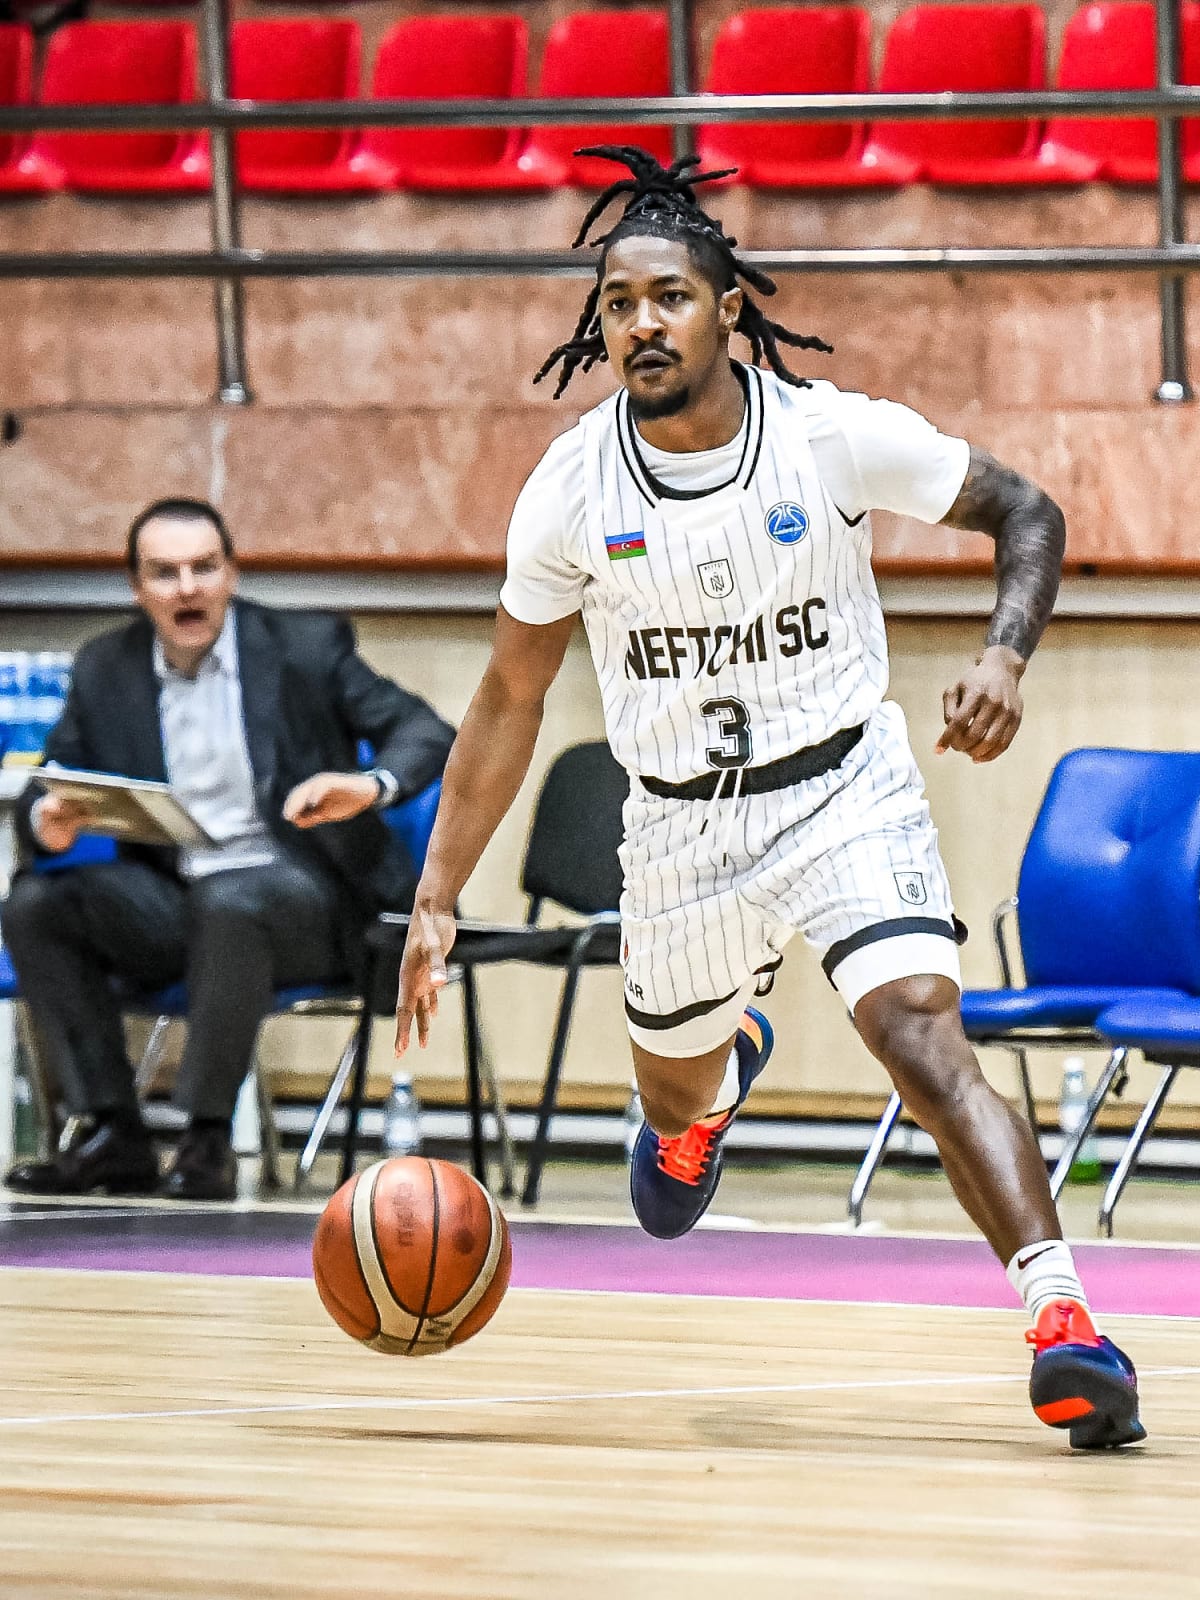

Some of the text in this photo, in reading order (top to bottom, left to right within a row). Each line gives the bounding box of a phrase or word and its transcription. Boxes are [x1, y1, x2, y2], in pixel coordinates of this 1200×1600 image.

[625, 597, 829, 680] NEFTCHI SC
[700, 696, 753, 769] 3
